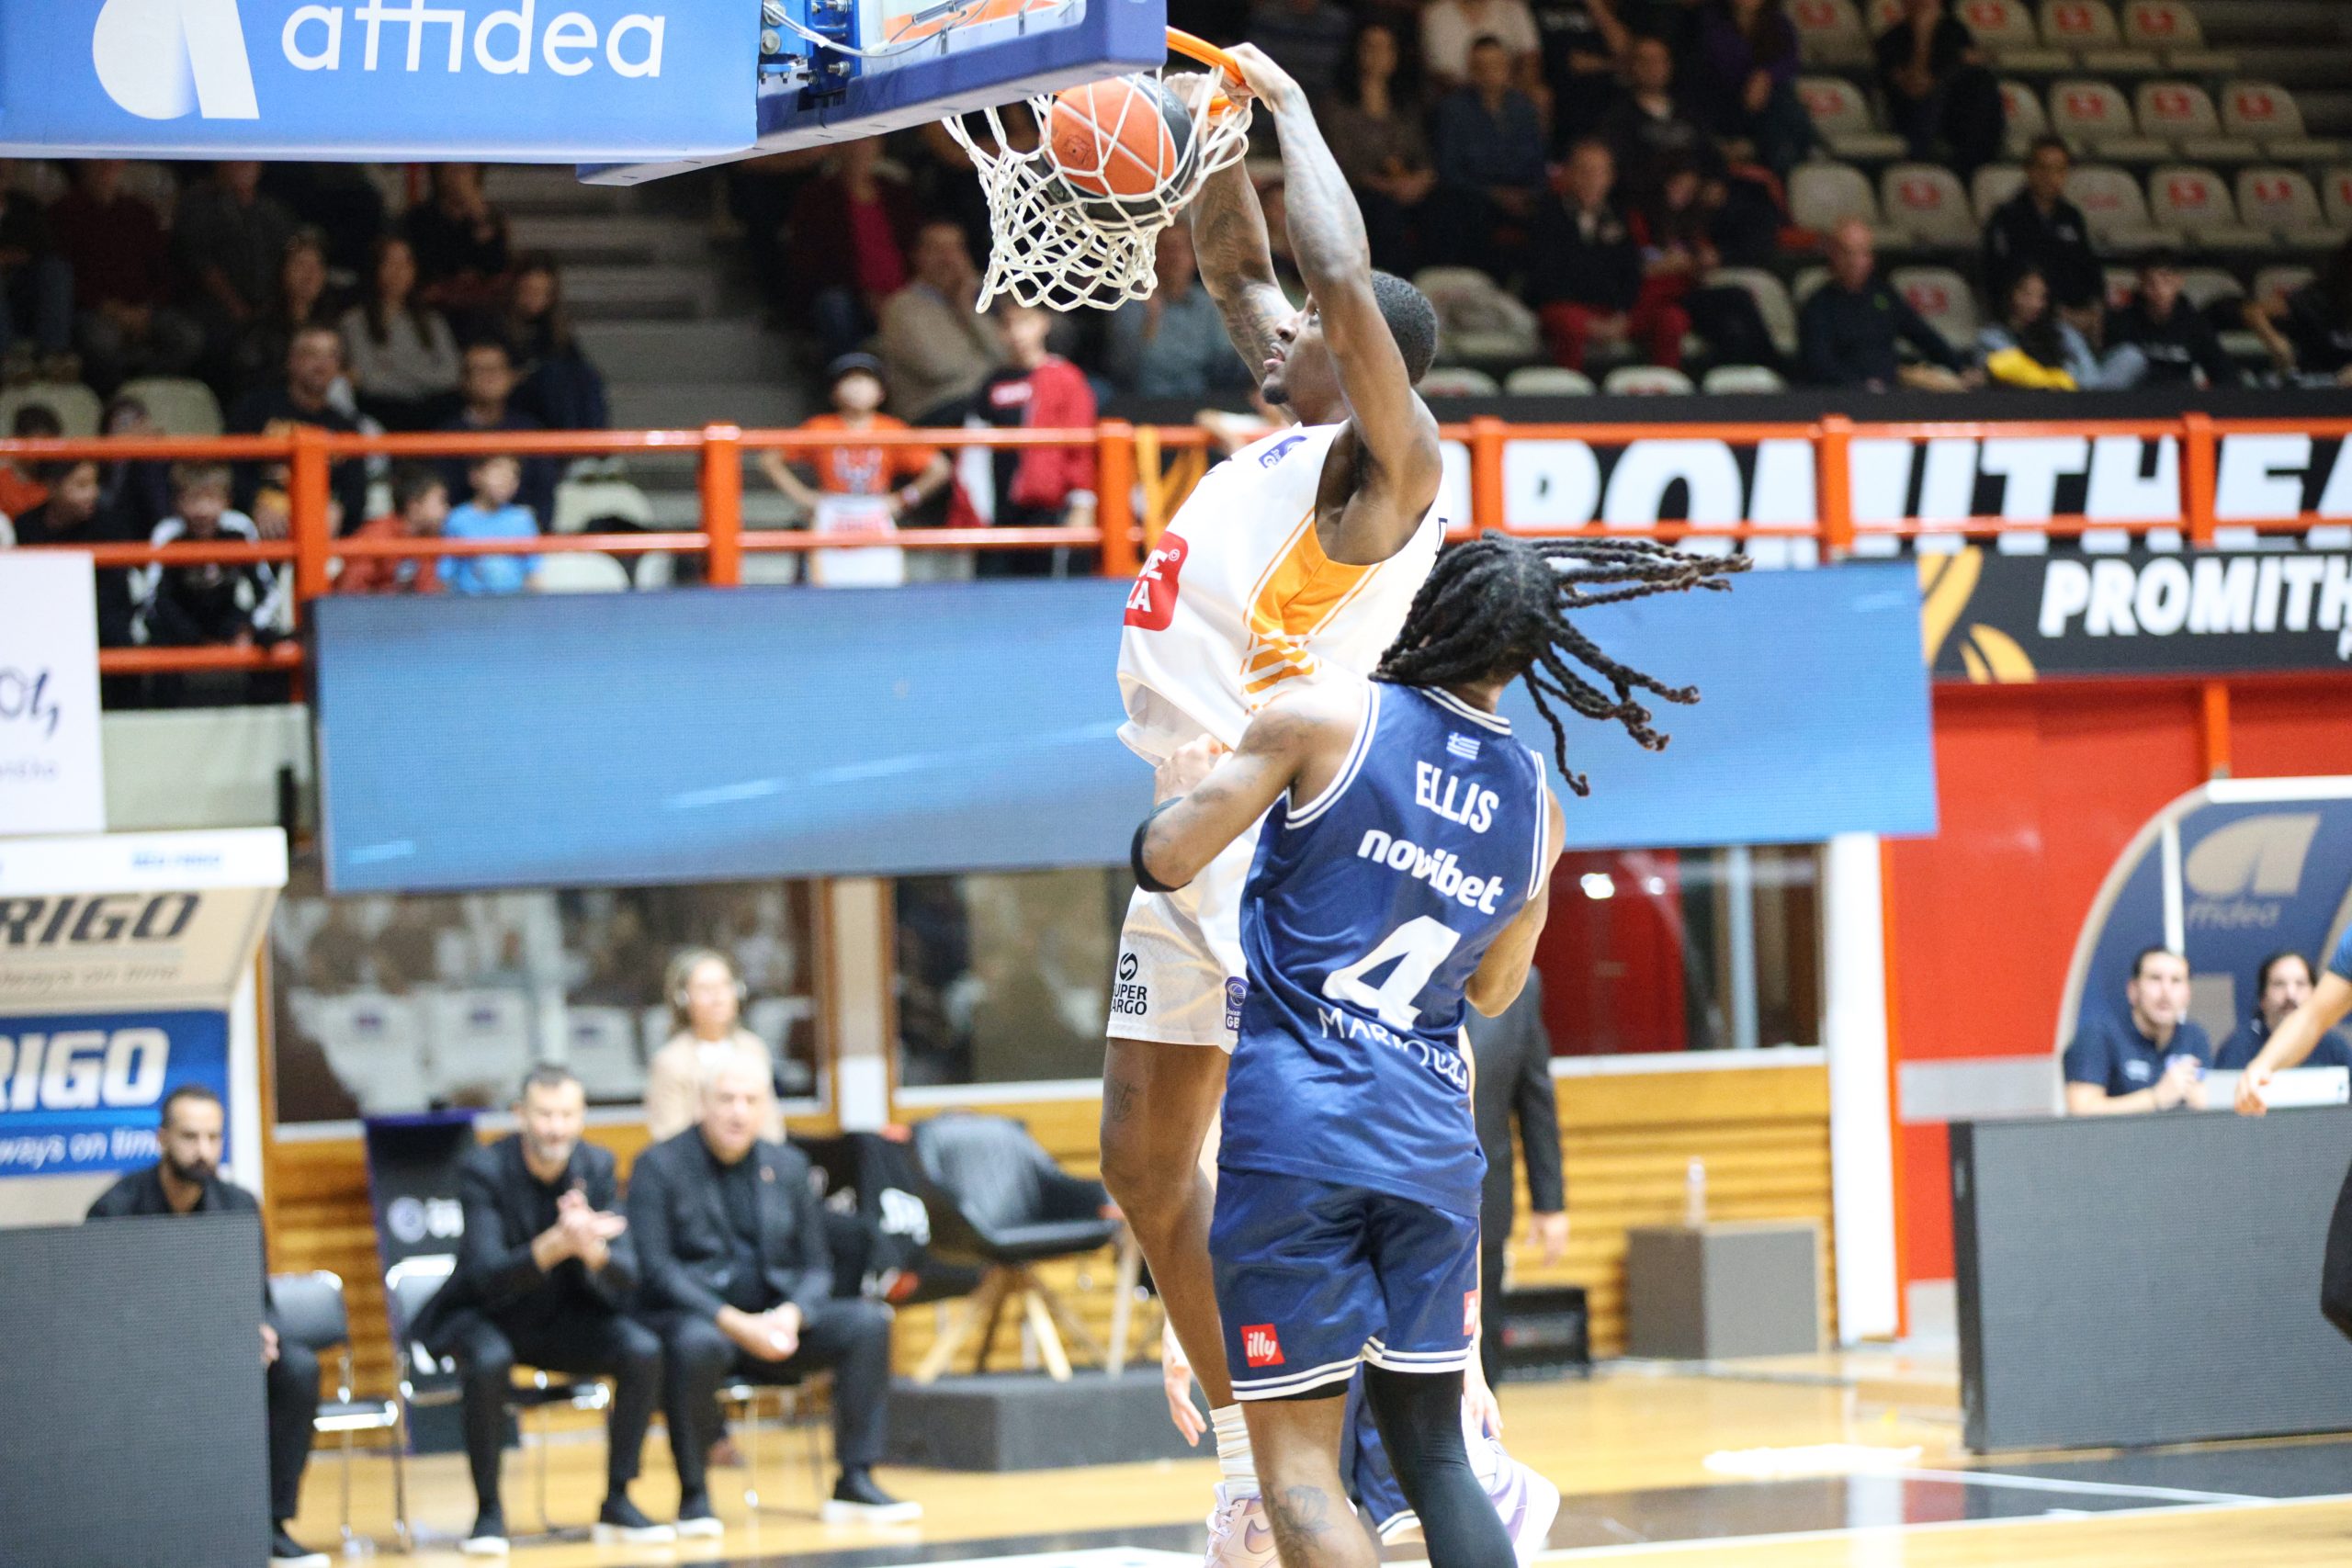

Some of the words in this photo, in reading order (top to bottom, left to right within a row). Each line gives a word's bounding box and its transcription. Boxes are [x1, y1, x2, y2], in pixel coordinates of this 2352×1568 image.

[1415, 760, 1499, 834] ELLIS
[1357, 829, 1505, 915] novibet
[1113, 983, 1147, 1001] UPER
[1321, 915, 1461, 1032] 4
[1112, 998, 1148, 1016] ARGO
[1248, 1331, 1276, 1361] illy
